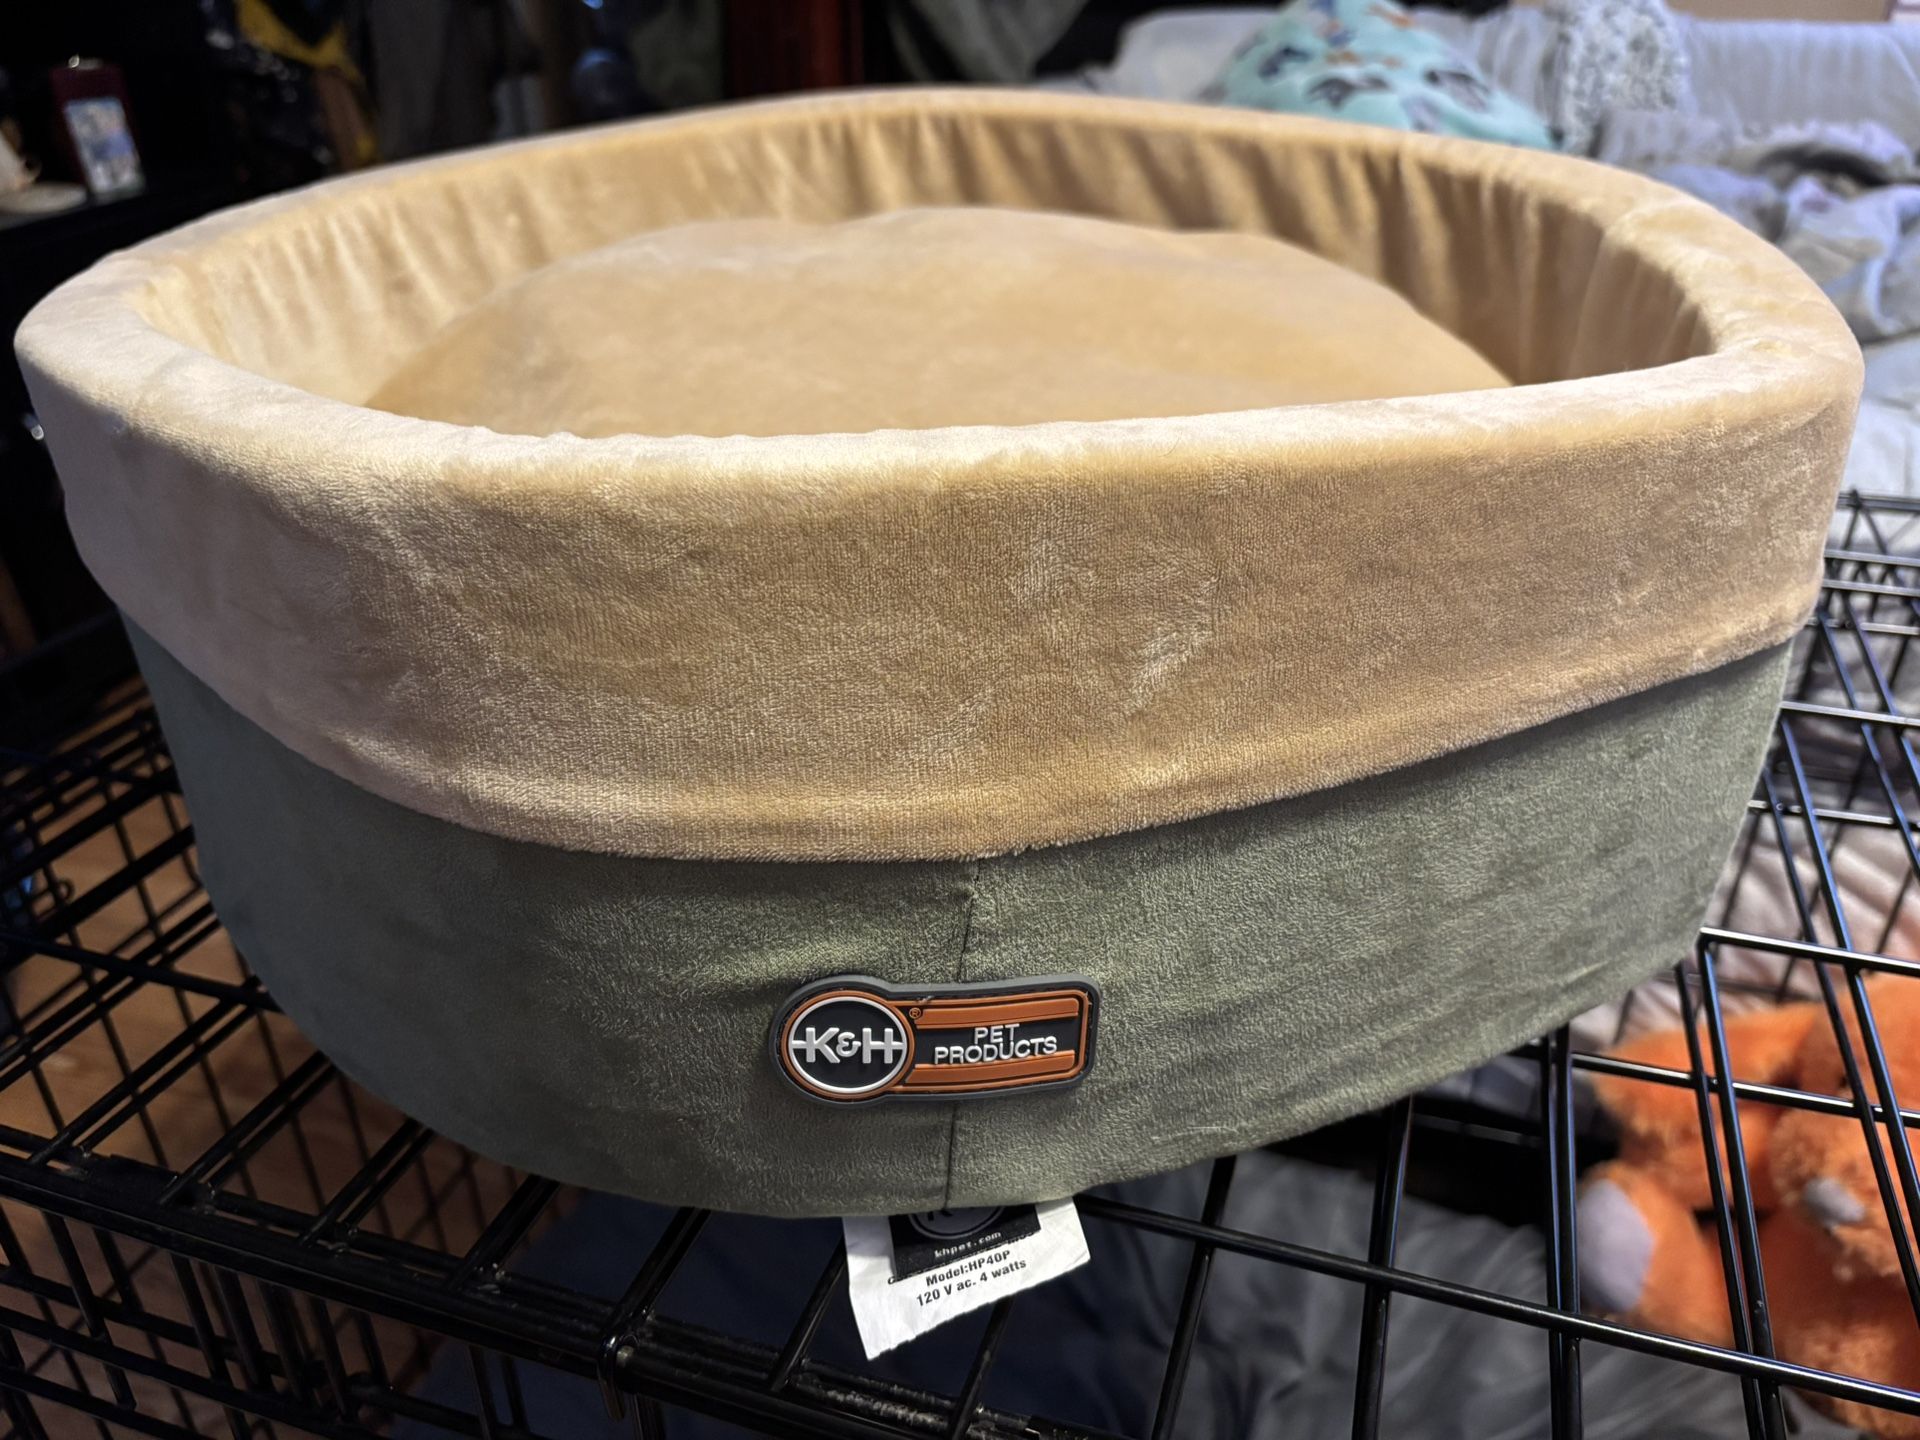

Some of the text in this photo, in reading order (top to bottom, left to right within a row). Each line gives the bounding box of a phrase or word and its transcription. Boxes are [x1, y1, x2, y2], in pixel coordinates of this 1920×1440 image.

[791, 1027, 907, 1063] K&H
[934, 1036, 1058, 1064] PRODUCTS
[974, 1023, 1020, 1046] PET
[934, 1231, 1002, 1258] khpet.com
[916, 1259, 1027, 1307] 120 V ac. 4 watts
[926, 1250, 1011, 1287] Model:HP40P
